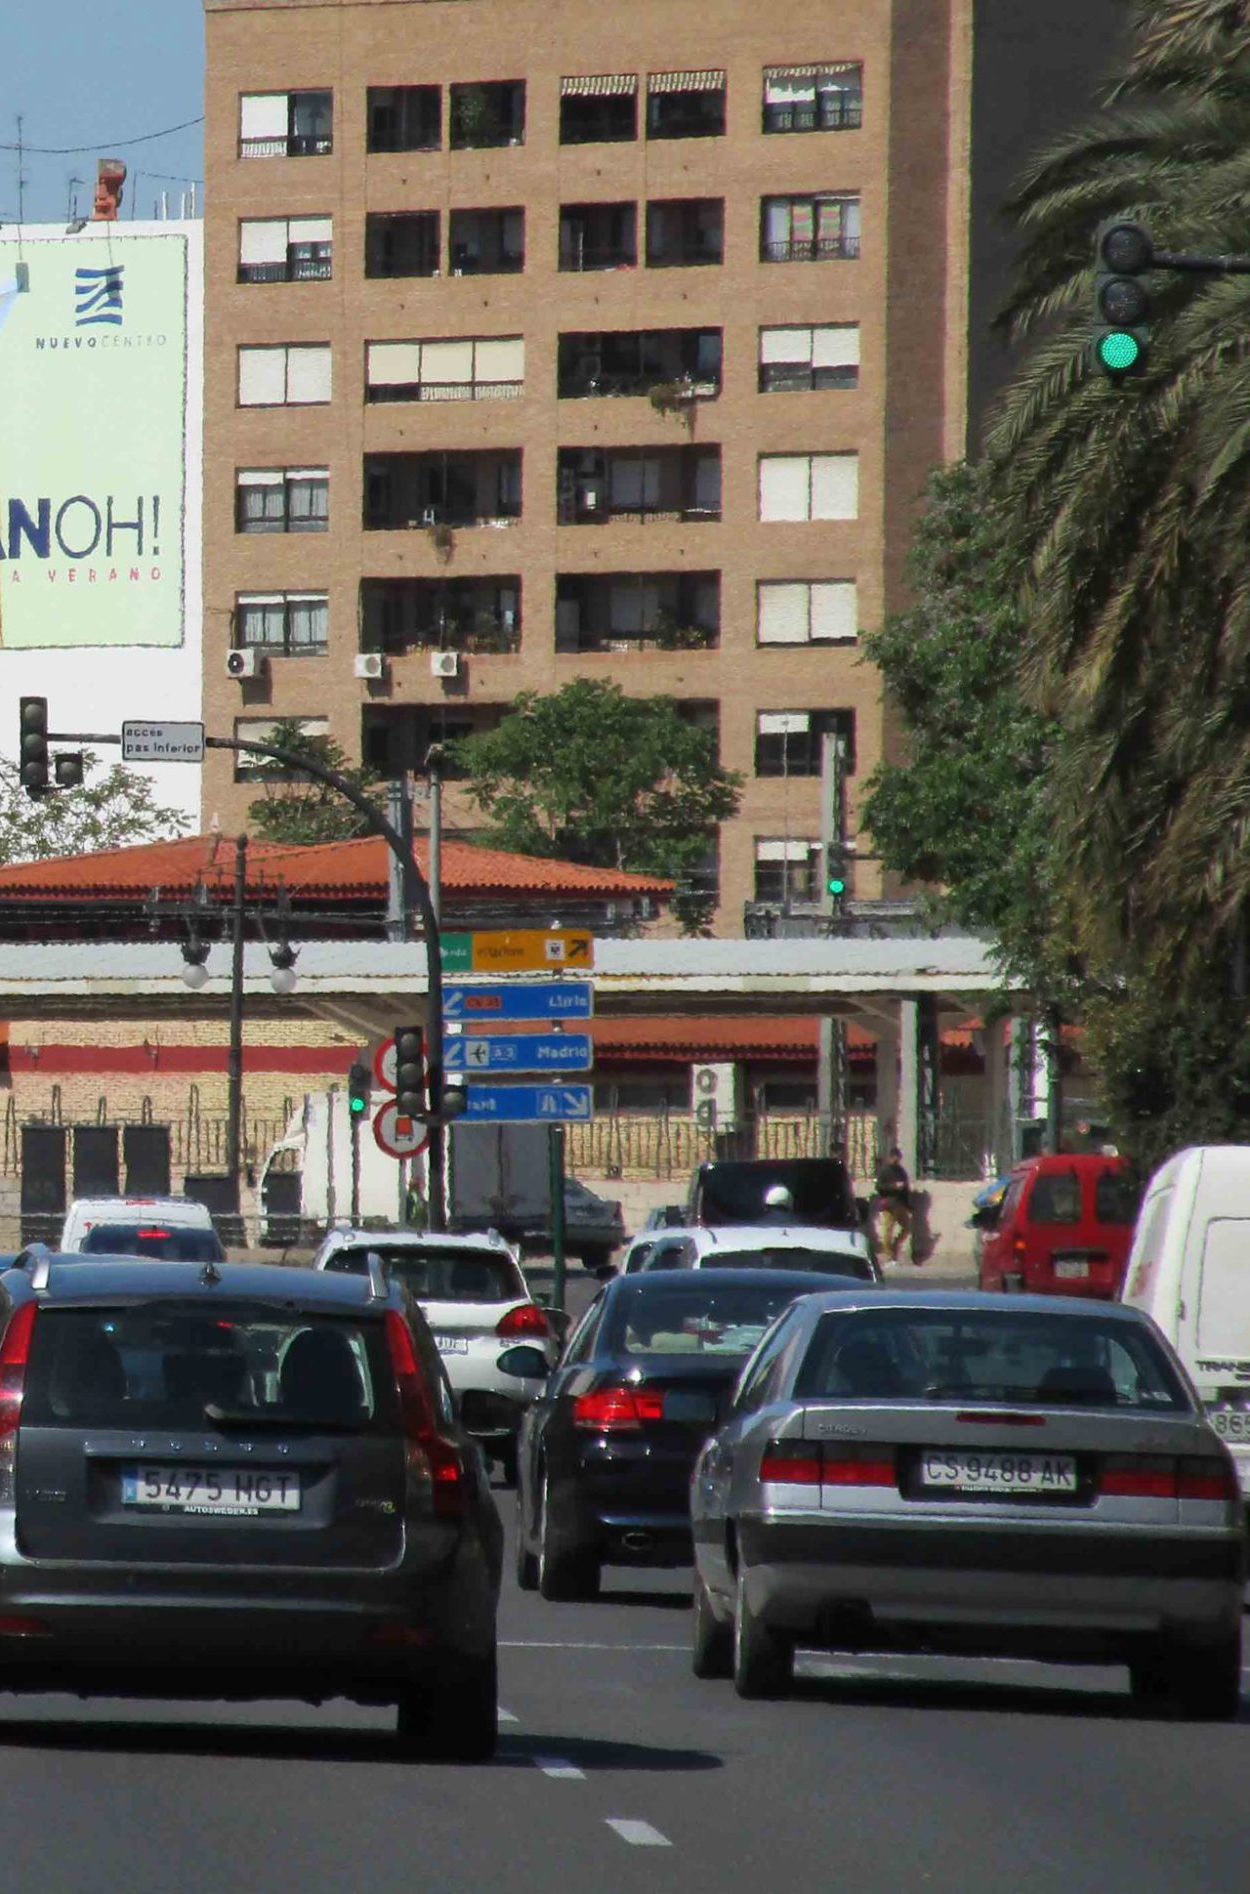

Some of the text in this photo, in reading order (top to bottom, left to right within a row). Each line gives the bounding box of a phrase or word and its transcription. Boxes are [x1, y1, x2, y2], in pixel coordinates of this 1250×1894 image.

[48, 566, 161, 583] VERANO
[126, 742, 201, 754] pas inferior
[537, 1046, 588, 1058] Madrid
[145, 1470, 290, 1503] 5475 HGT
